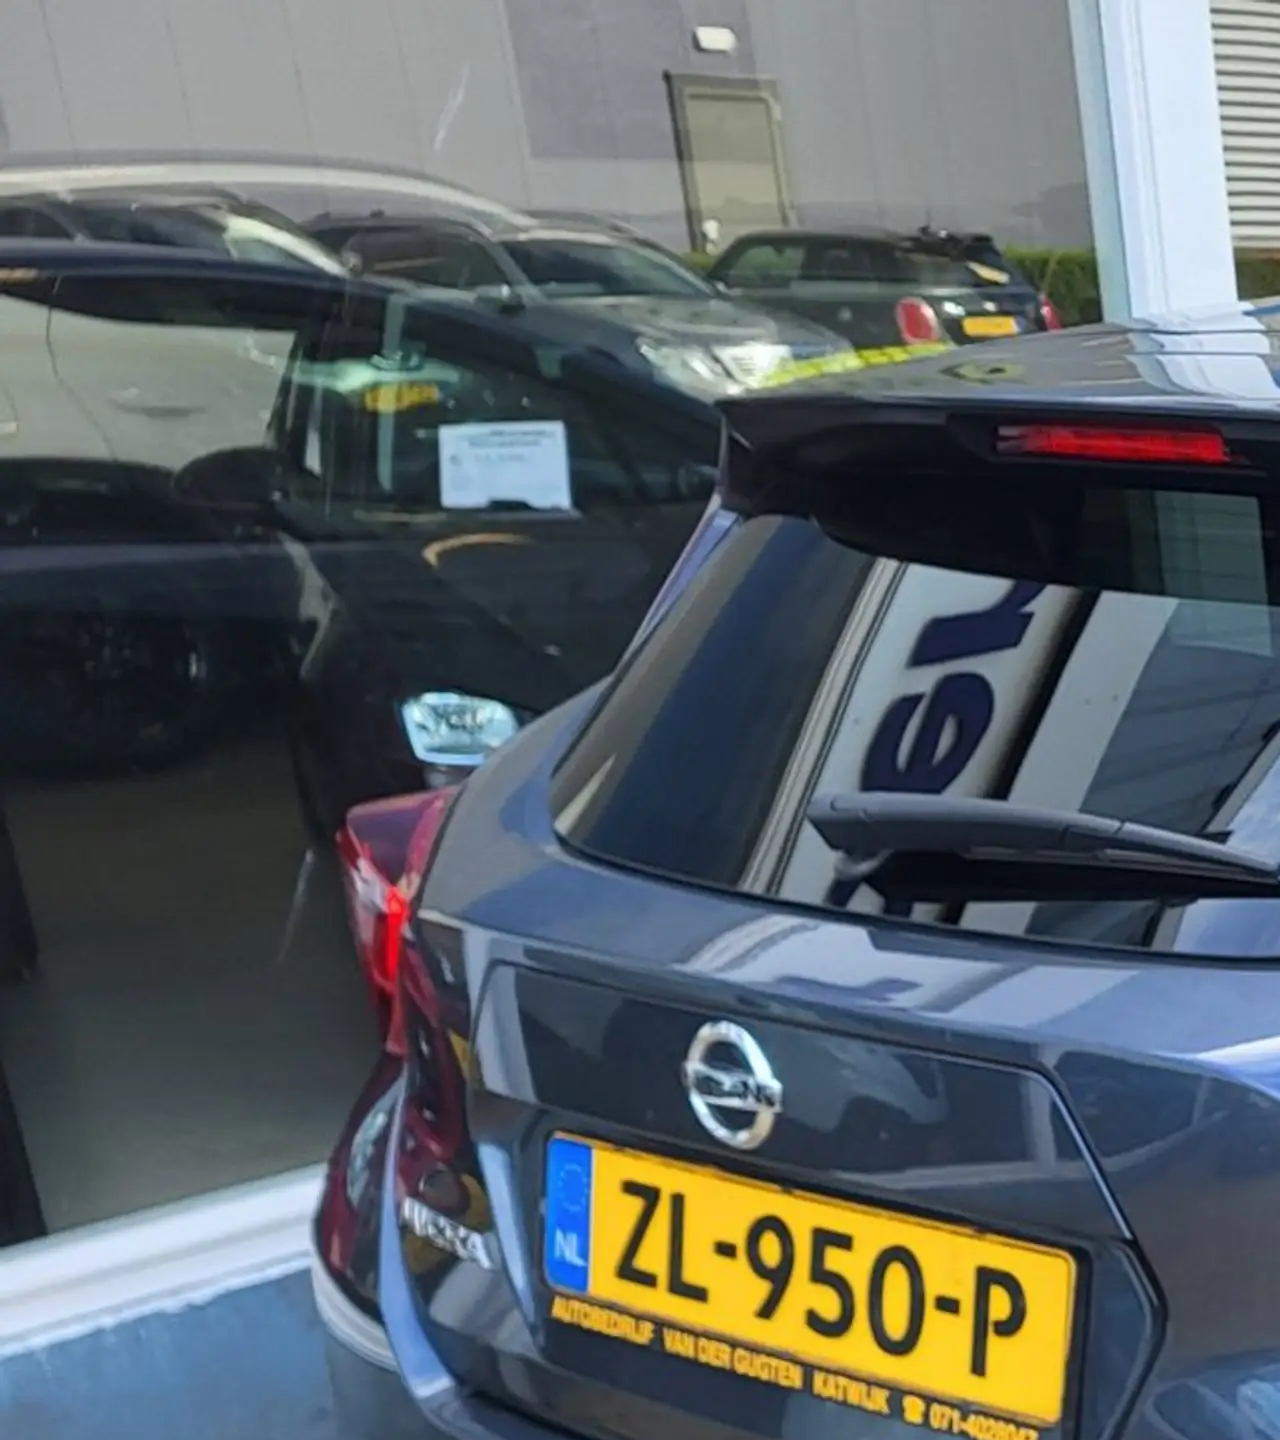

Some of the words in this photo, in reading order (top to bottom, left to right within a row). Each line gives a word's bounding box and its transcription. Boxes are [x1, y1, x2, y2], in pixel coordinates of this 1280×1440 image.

[553, 1232, 587, 1265] NL
[615, 1180, 1027, 1378] ZL-950-P
[663, 1326, 696, 1360] VAN
[697, 1336, 731, 1370] DER
